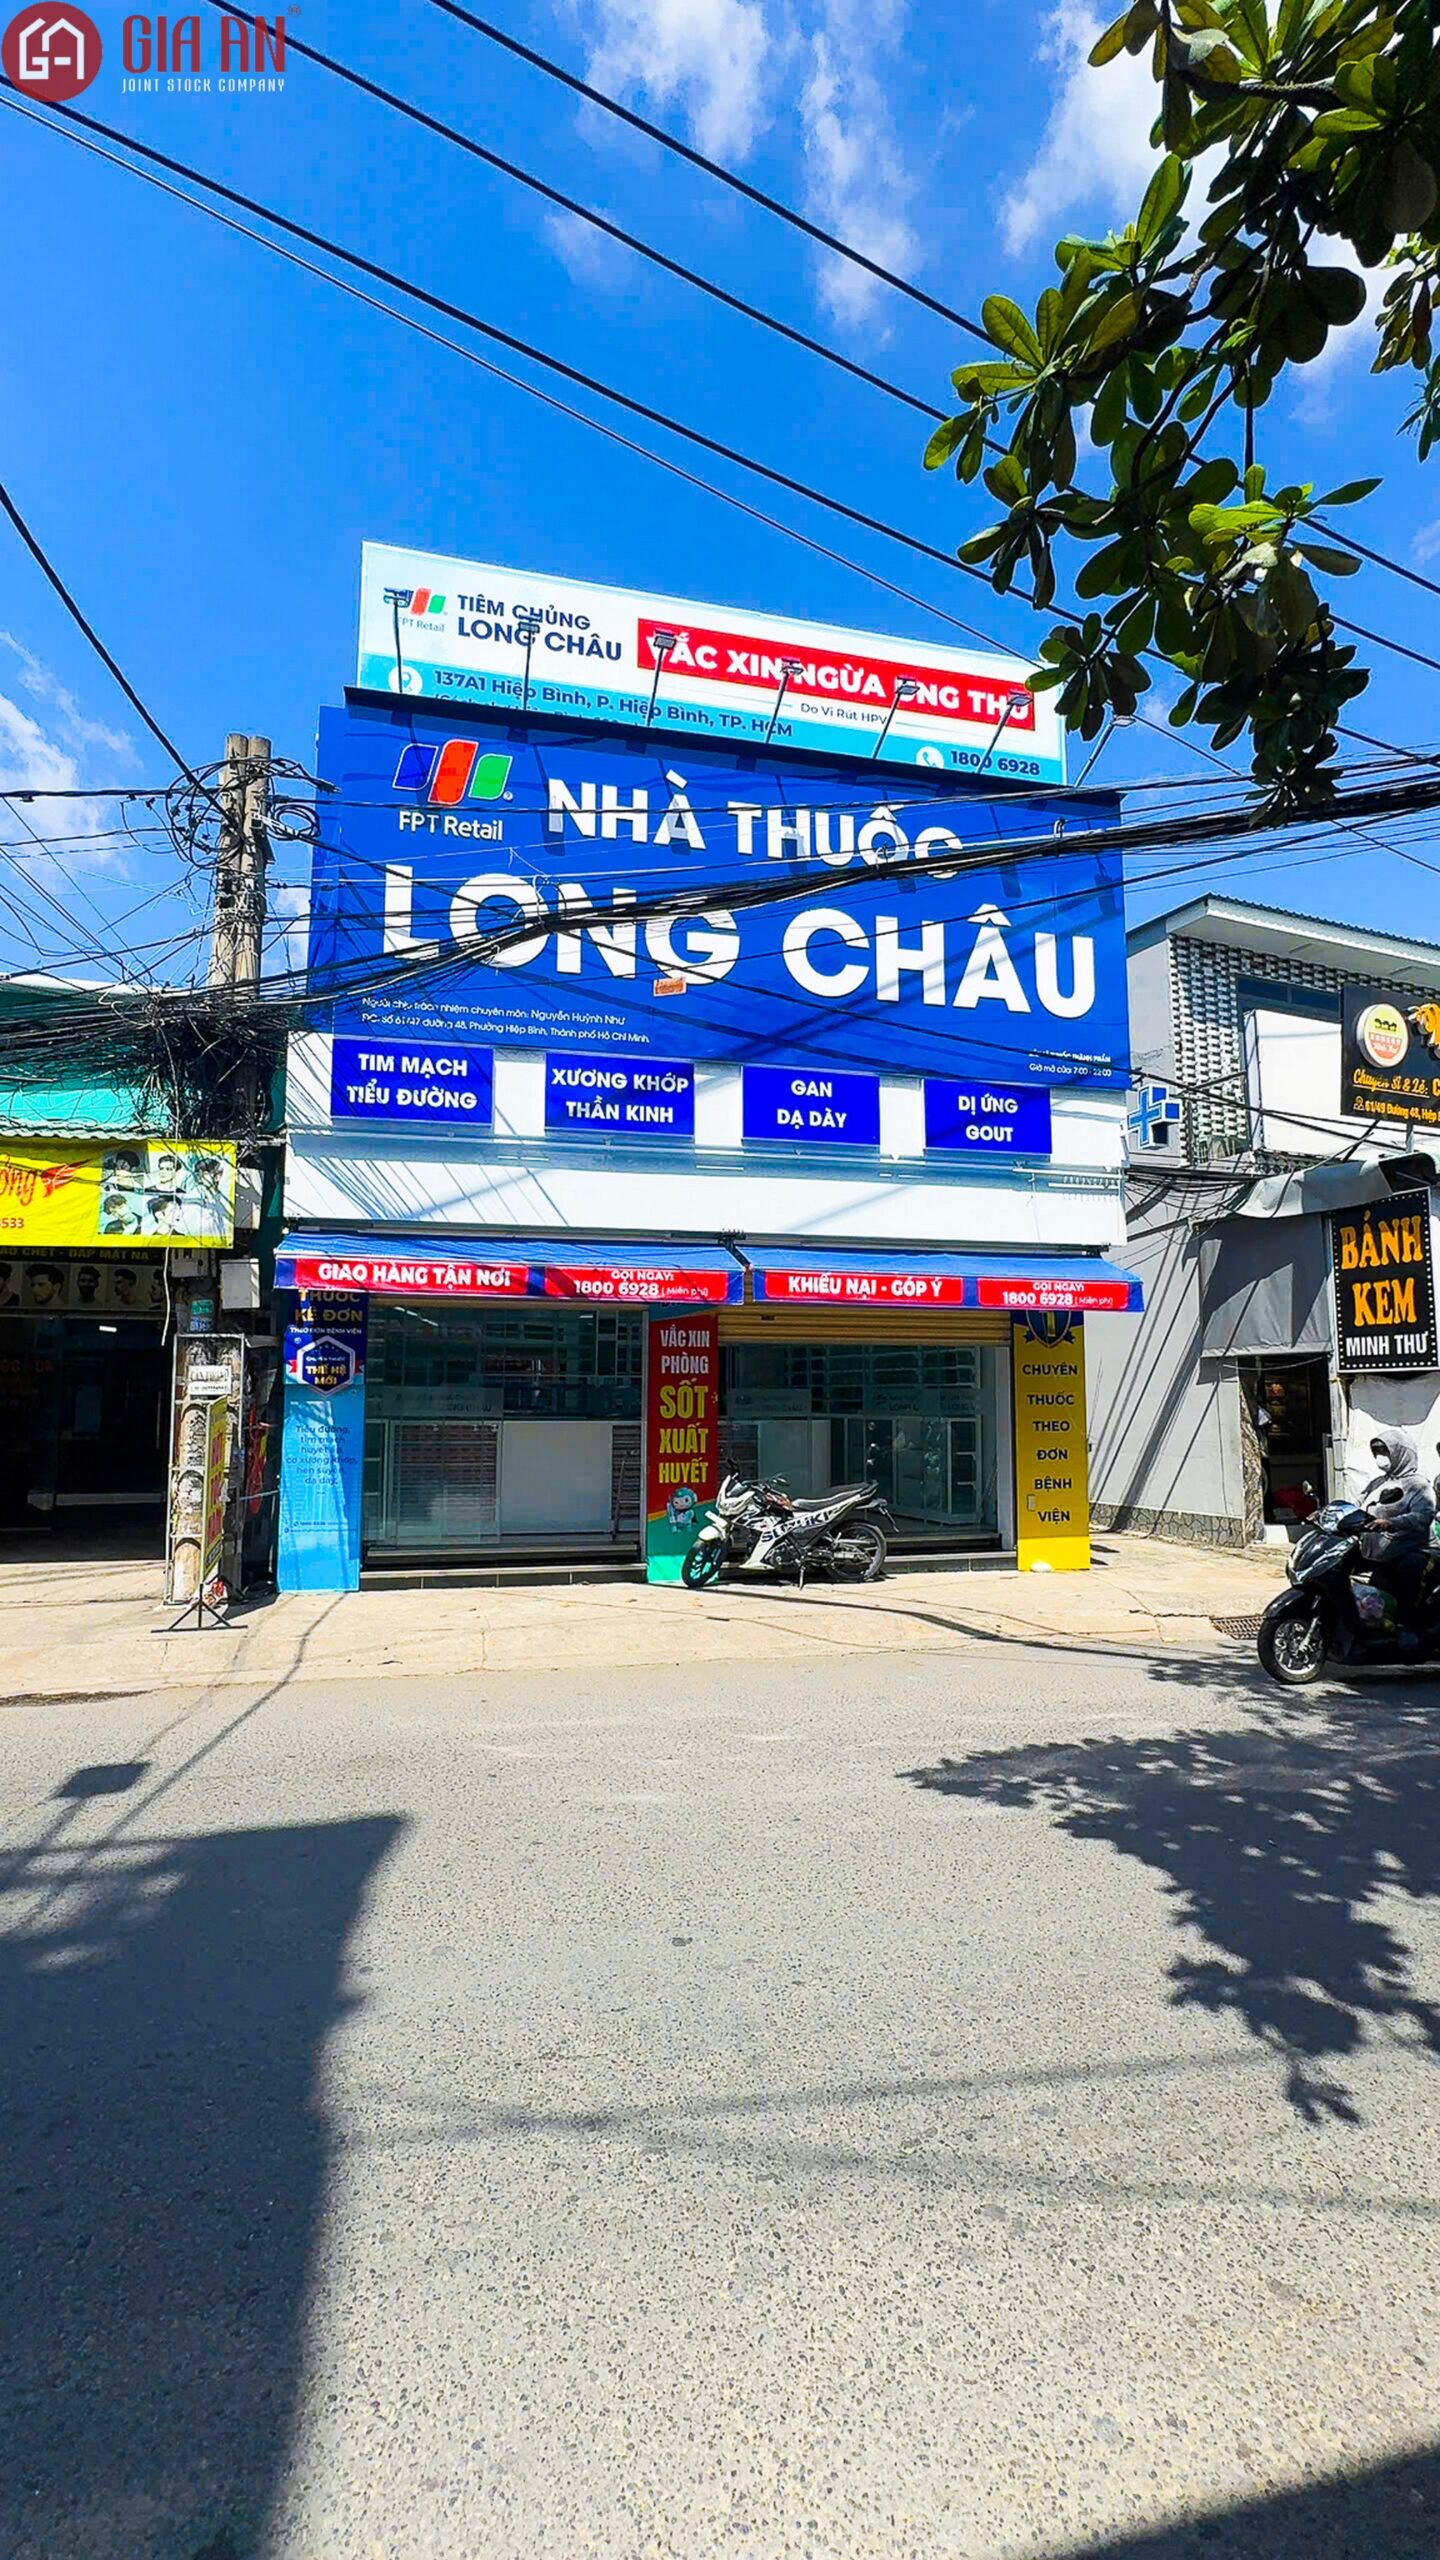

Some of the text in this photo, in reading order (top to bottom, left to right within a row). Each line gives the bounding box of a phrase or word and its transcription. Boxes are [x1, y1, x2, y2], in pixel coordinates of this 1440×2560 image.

[457, 594, 591, 631] TIÊM CHỦNG
[417, 620, 445, 633] Retail
[458, 617, 622, 661] LONG CHÂU
[726, 650, 784, 681] XIN
[793, 661, 886, 698] NGỪA
[434, 670, 486, 690] 137A1
[492, 680, 537, 700] Hiệp
[543, 687, 592, 708] Bình,
[597, 696, 613, 710] P.
[619, 699, 662, 722] Hiệp
[667, 705, 714, 728] Bình,
[719, 713, 746, 729] TP.
[801, 703, 817, 714] Do
[837, 707, 858, 720] Rút
[861, 713, 887, 725] HPV
[950, 751, 1040, 775] 1800 6928
[399, 811, 503, 841] FPT Retail
[548, 769, 963, 879] NHÀ THUỐC
[383, 864, 1095, 1019] LONG CHÂU
[440, 1004, 469, 1014] nhiệm
[470, 1006, 504, 1017] chuyên
[506, 1010, 529, 1018] môn:
[531, 1009, 570, 1021] Nguyễn
[572, 1013, 603, 1024] Huỳnh
[604, 1015, 626, 1025] Như
[506, 1024, 526, 1034] Hiệp
[551, 1027, 577, 1037] Thành
[578, 1029, 597, 1039] phố
[598, 1031, 610, 1040] Hồ
[358, 1053, 468, 1080] TIM MẠCH
[551, 1068, 689, 1093] XƯƠNG KHỚP
[791, 1080, 833, 1097] GAN
[347, 1078, 478, 1110] TIỂU ĐƯỜNG
[958, 1093, 1019, 1116] DỊ ỨNG
[566, 1096, 674, 1123] THẦN KINH
[776, 1107, 847, 1130] DẠ DÀY
[966, 1125, 1014, 1142] GOUT
[0, 1217, 24, 1229] 533
[1340, 1210, 1424, 1270] BÁNH
[318, 1263, 511, 1290] GIAO HÀNG TẬN NƠI
[611, 1270, 674, 1281] GỌI NGAY:
[788, 1272, 842, 1296] KHIẾU
[846, 1277, 876, 1300] NẠI
[891, 1276, 928, 1297] GÓP
[930, 1277, 942, 1297] Ý
[1033, 1282, 1052, 1292] GỌI
[573, 1280, 614, 1295] 1800
[618, 1282, 659, 1296] 6928
[1002, 1292, 1036, 1305] 1800
[1040, 1292, 1073, 1305] 6928
[1352, 1277, 1417, 1327] KEM
[323, 1308, 363, 1322] ĐƠN
[688, 1331, 710, 1348] XIN
[1346, 1331, 1429, 1357] MINH THƯ
[660, 1352, 709, 1374] PHÒNG
[1022, 1362, 1077, 1375] CHUYÊN
[314, 1375, 337, 1385] MỚI
[659, 1378, 708, 1419] SỐT
[1027, 1390, 1074, 1405] THUỐC
[659, 1422, 708, 1454] XUẤT
[1033, 1421, 1070, 1432] THEO
[1037, 1447, 1068, 1460] ĐƠN
[659, 1458, 707, 1484] HUYẾT
[1034, 1474, 1072, 1492] BỆNH
[1037, 1508, 1070, 1525] VIỆN
